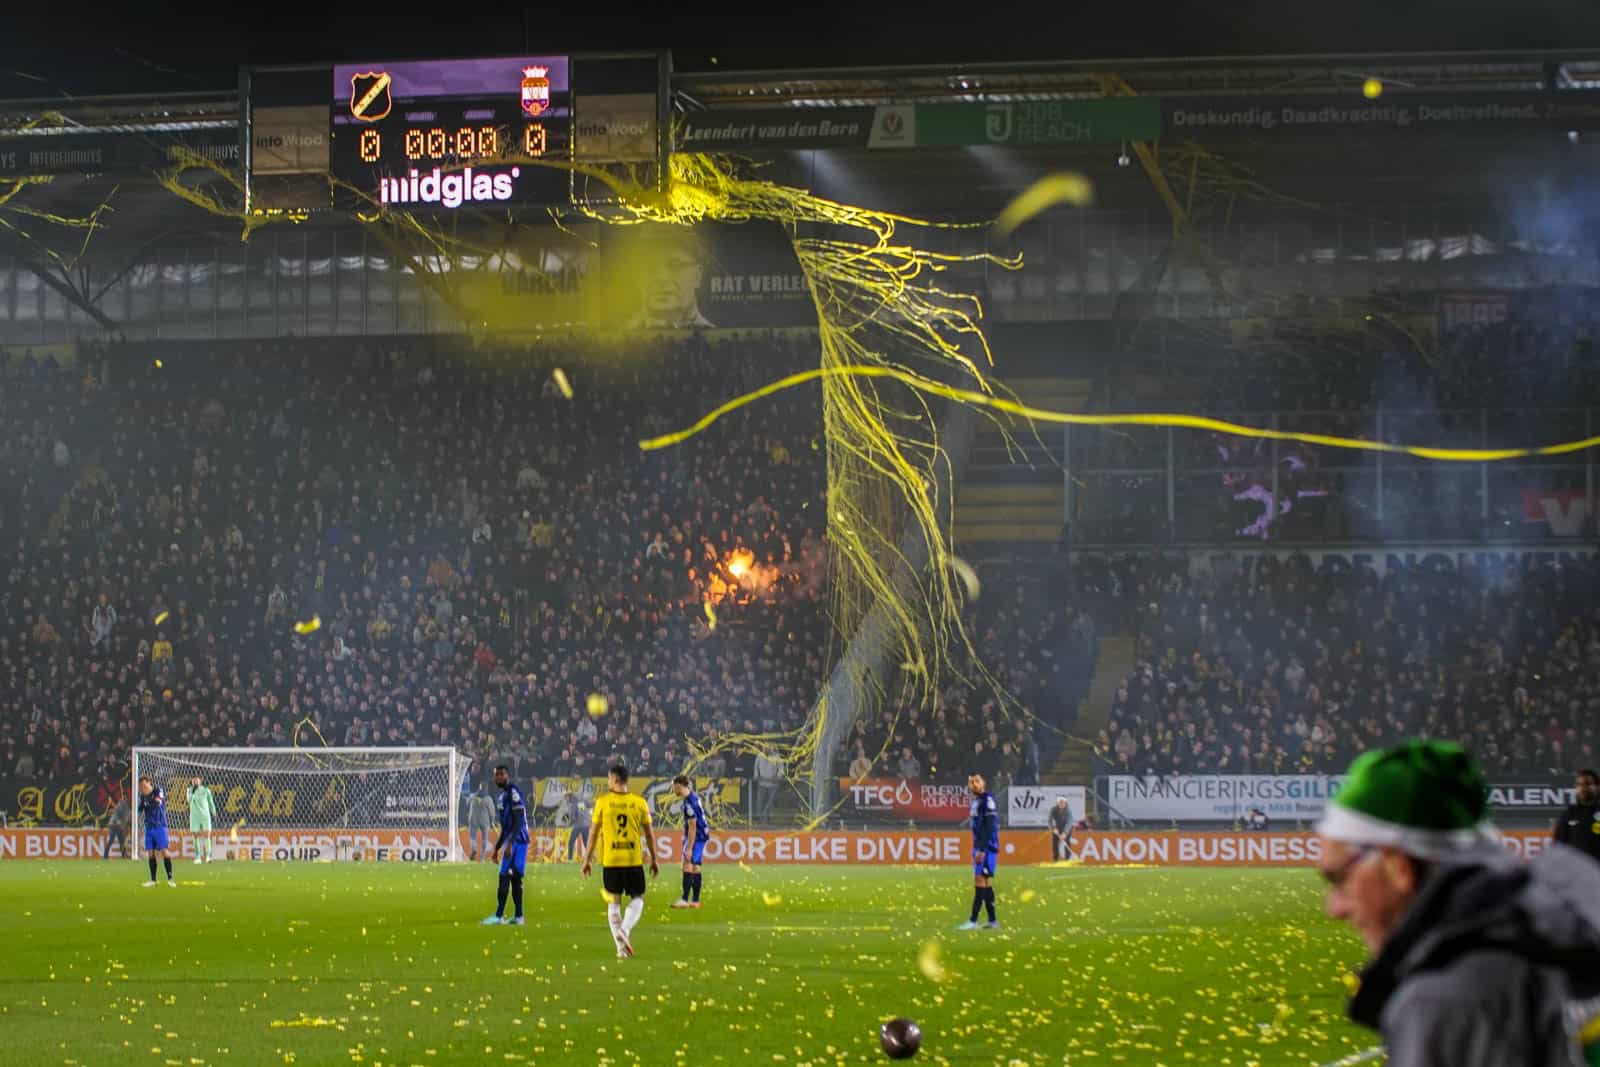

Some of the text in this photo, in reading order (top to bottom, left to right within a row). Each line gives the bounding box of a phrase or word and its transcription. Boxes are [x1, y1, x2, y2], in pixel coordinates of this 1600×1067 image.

[361, 129, 380, 162] 0
[406, 126, 497, 160] 00:00
[525, 123, 546, 156] 0
[849, 785, 893, 805] TFC
[1012, 789, 1045, 809] sbr
[775, 837, 847, 861] ELKE
[856, 837, 961, 861] DIVISIE
[1178, 837, 1322, 861] BUSINESS
